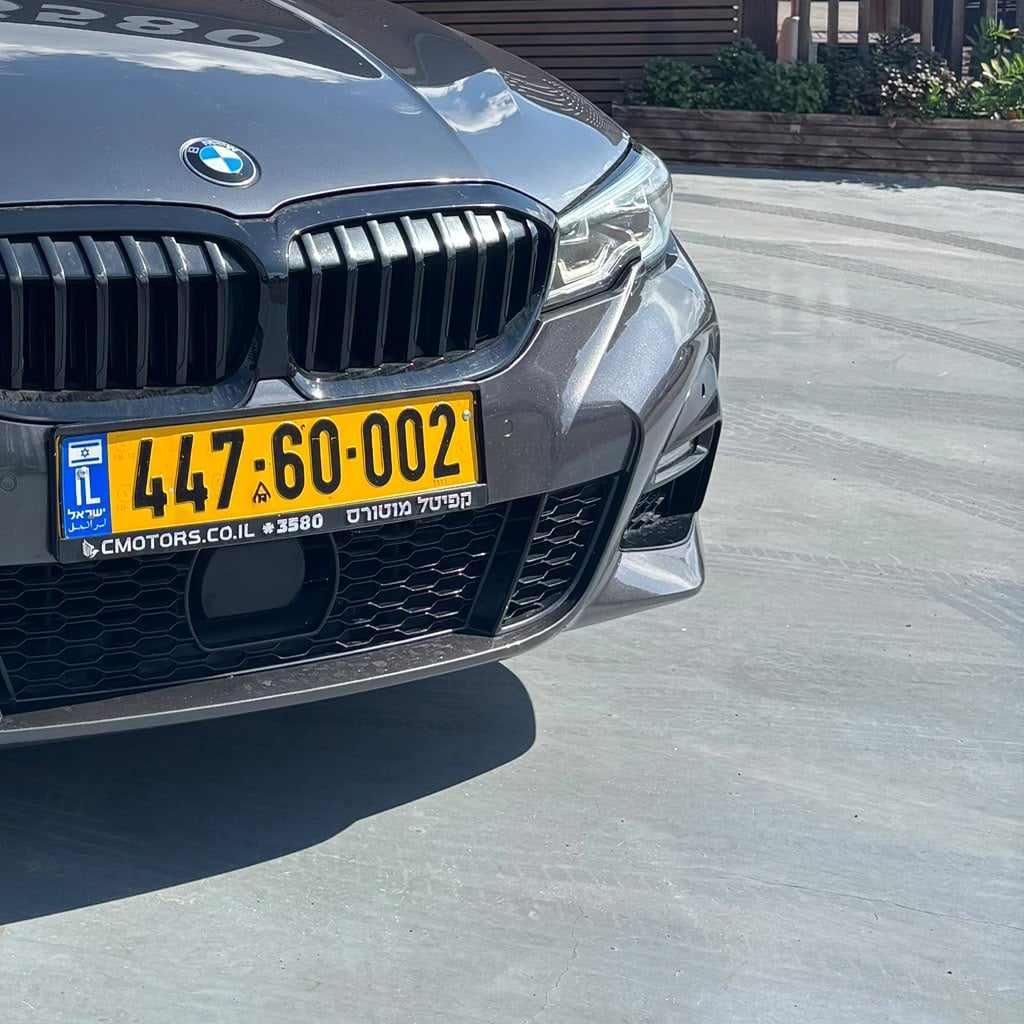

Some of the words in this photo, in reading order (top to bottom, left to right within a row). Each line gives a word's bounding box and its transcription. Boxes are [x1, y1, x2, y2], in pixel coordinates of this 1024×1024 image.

[75, 466, 101, 506] IL
[67, 507, 106, 520] ישראל
[346, 501, 412, 524] מוטורס
[417, 491, 472, 513] קפיטל
[101, 523, 255, 555] CMOTORS.CO.IL
